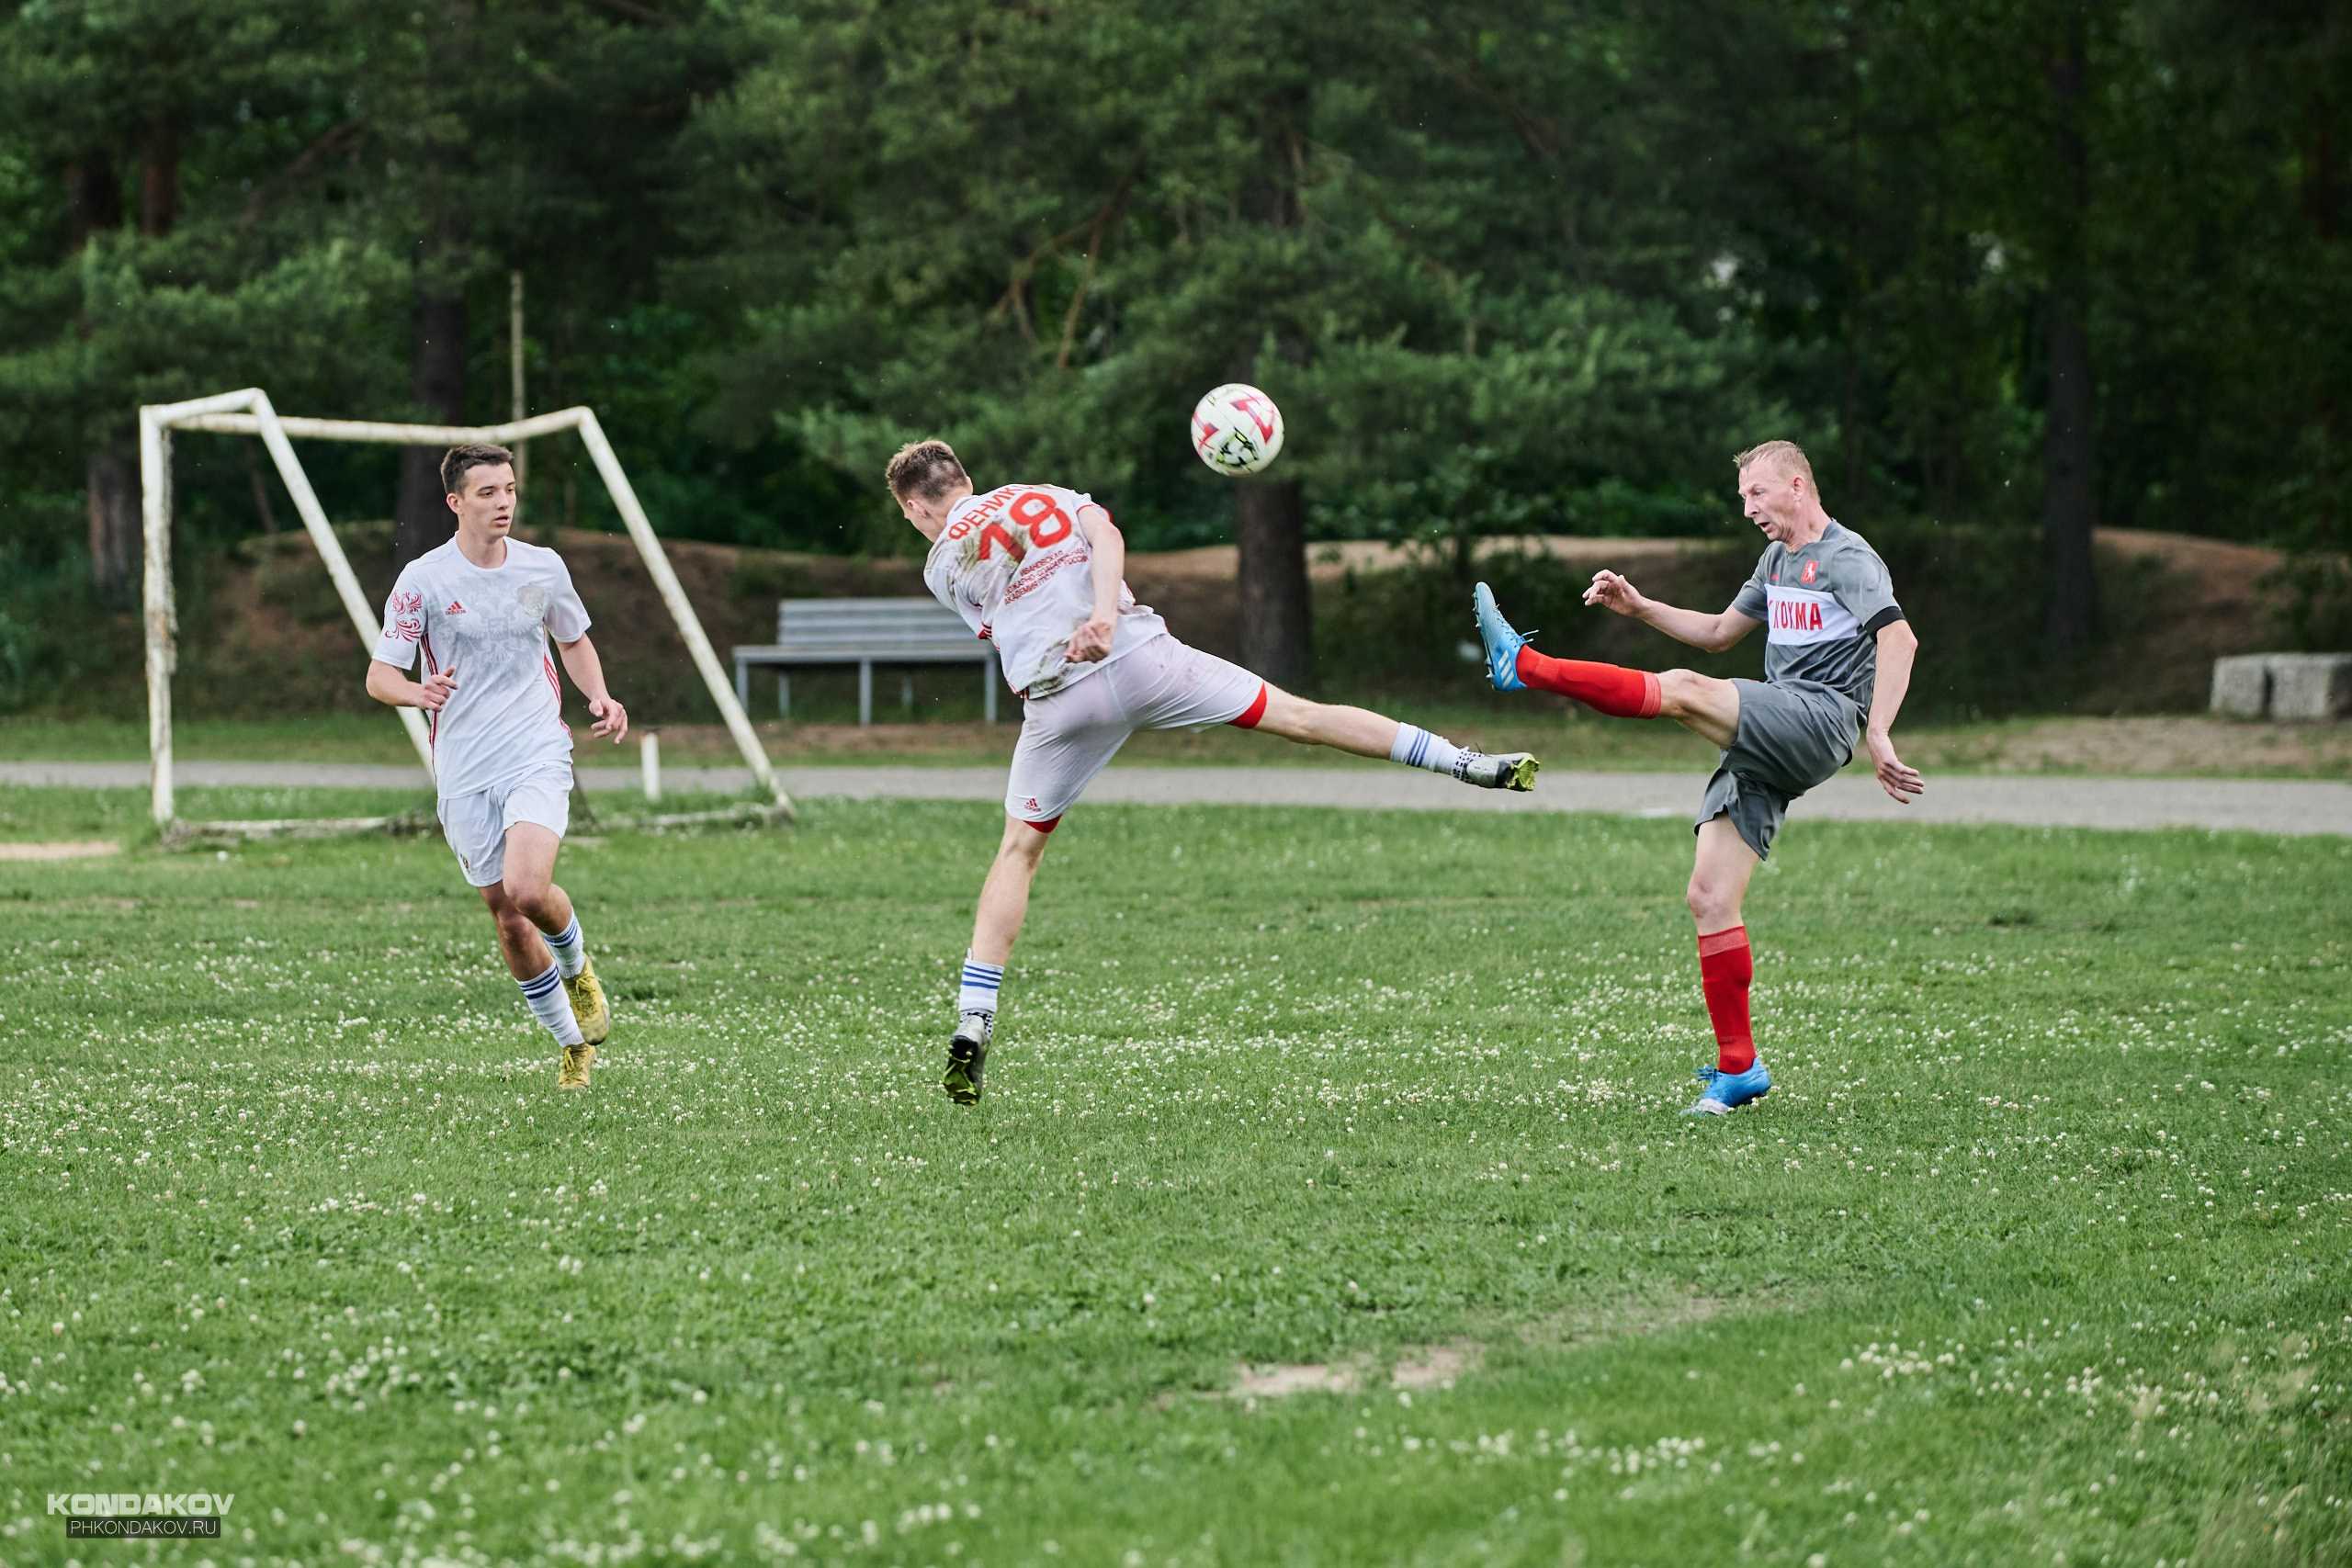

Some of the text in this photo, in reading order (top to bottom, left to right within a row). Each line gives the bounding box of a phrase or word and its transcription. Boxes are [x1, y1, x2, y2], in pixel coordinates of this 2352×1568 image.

[978, 491, 1072, 564] 18
[1020, 550, 1064, 577] ИВАНОВСКАЯ
[1004, 581, 1038, 605] АКАДЕМИЯ
